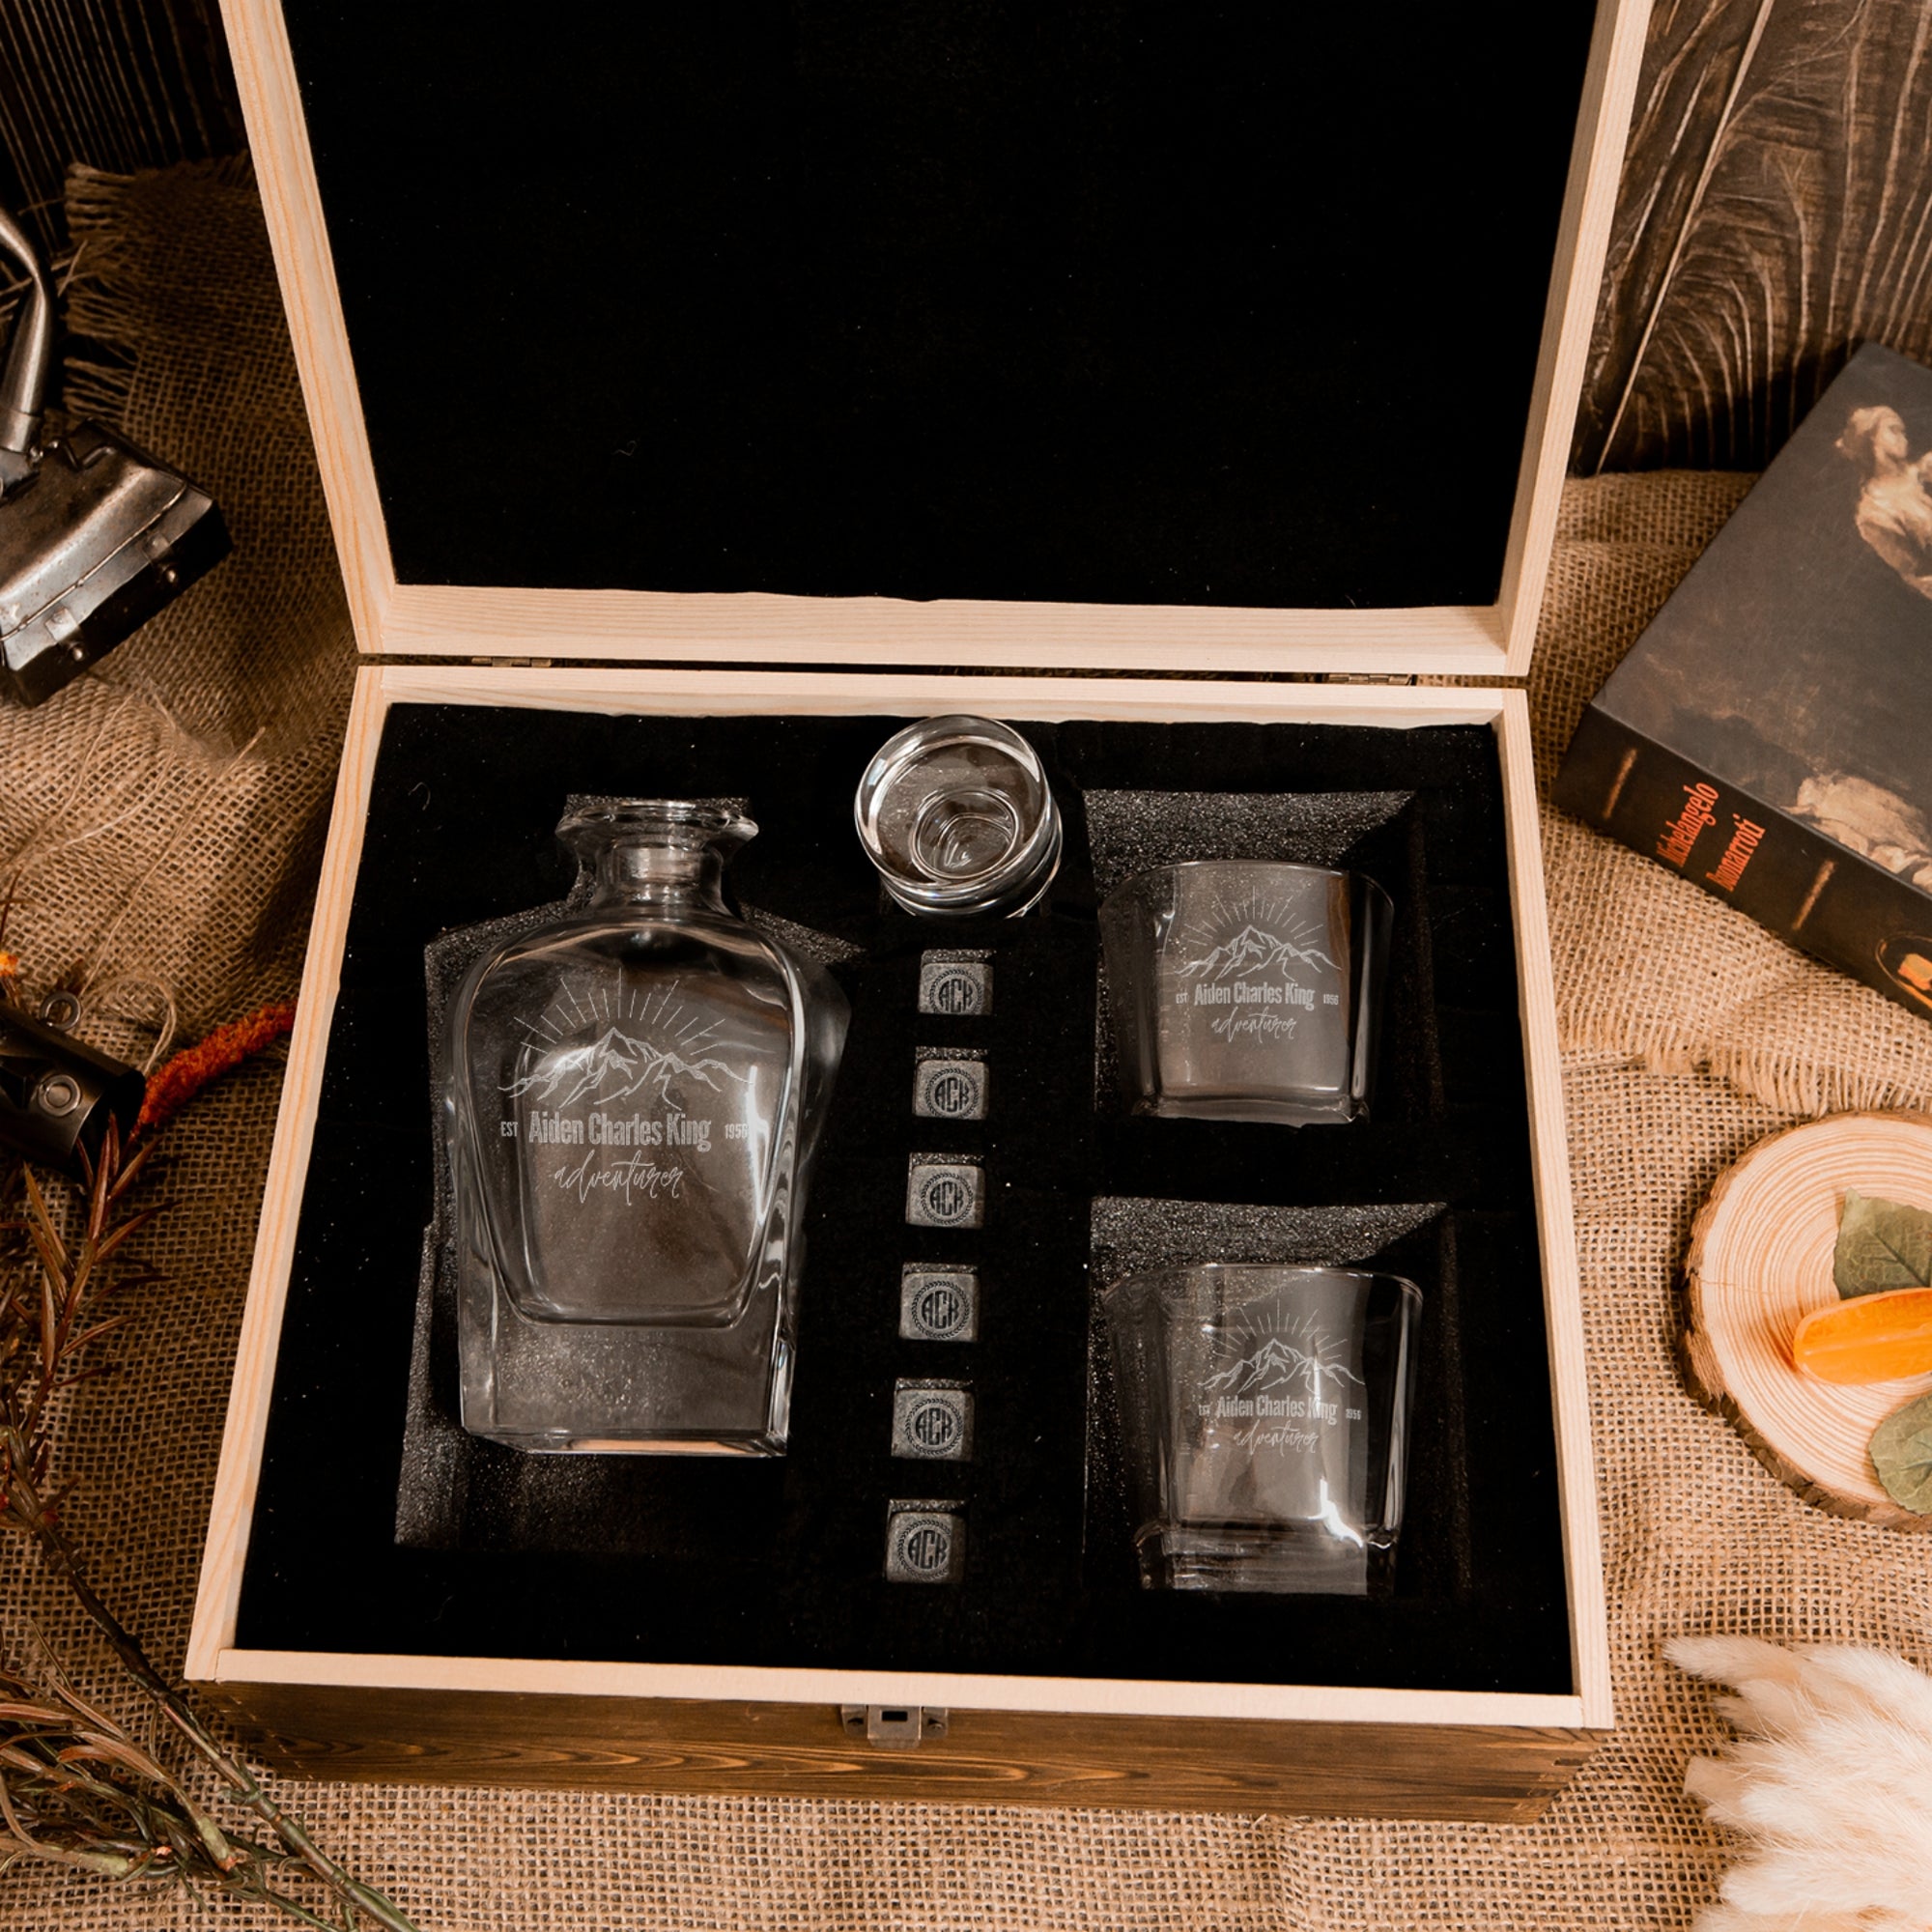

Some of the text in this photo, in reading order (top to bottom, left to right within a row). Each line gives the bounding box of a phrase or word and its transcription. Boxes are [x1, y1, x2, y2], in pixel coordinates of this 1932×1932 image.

[1656, 781, 1719, 867] Michelangelo
[1705, 813, 1766, 893] Buonarroti
[1176, 992, 1188, 1005] EST
[1194, 982, 1232, 1006] Aiden
[1234, 981, 1282, 1005] Charles
[1285, 982, 1315, 1011] King
[1211, 1007, 1297, 1044] adventurer
[500, 1111, 750, 1152] EST Aiden Charles King 1956
[554, 1150, 684, 1206] adventurer
[1216, 1396, 1254, 1418] Aiden
[1256, 1395, 1305, 1418] Charles
[1308, 1397, 1338, 1425] King
[1233, 1419, 1320, 1458] adventurer
